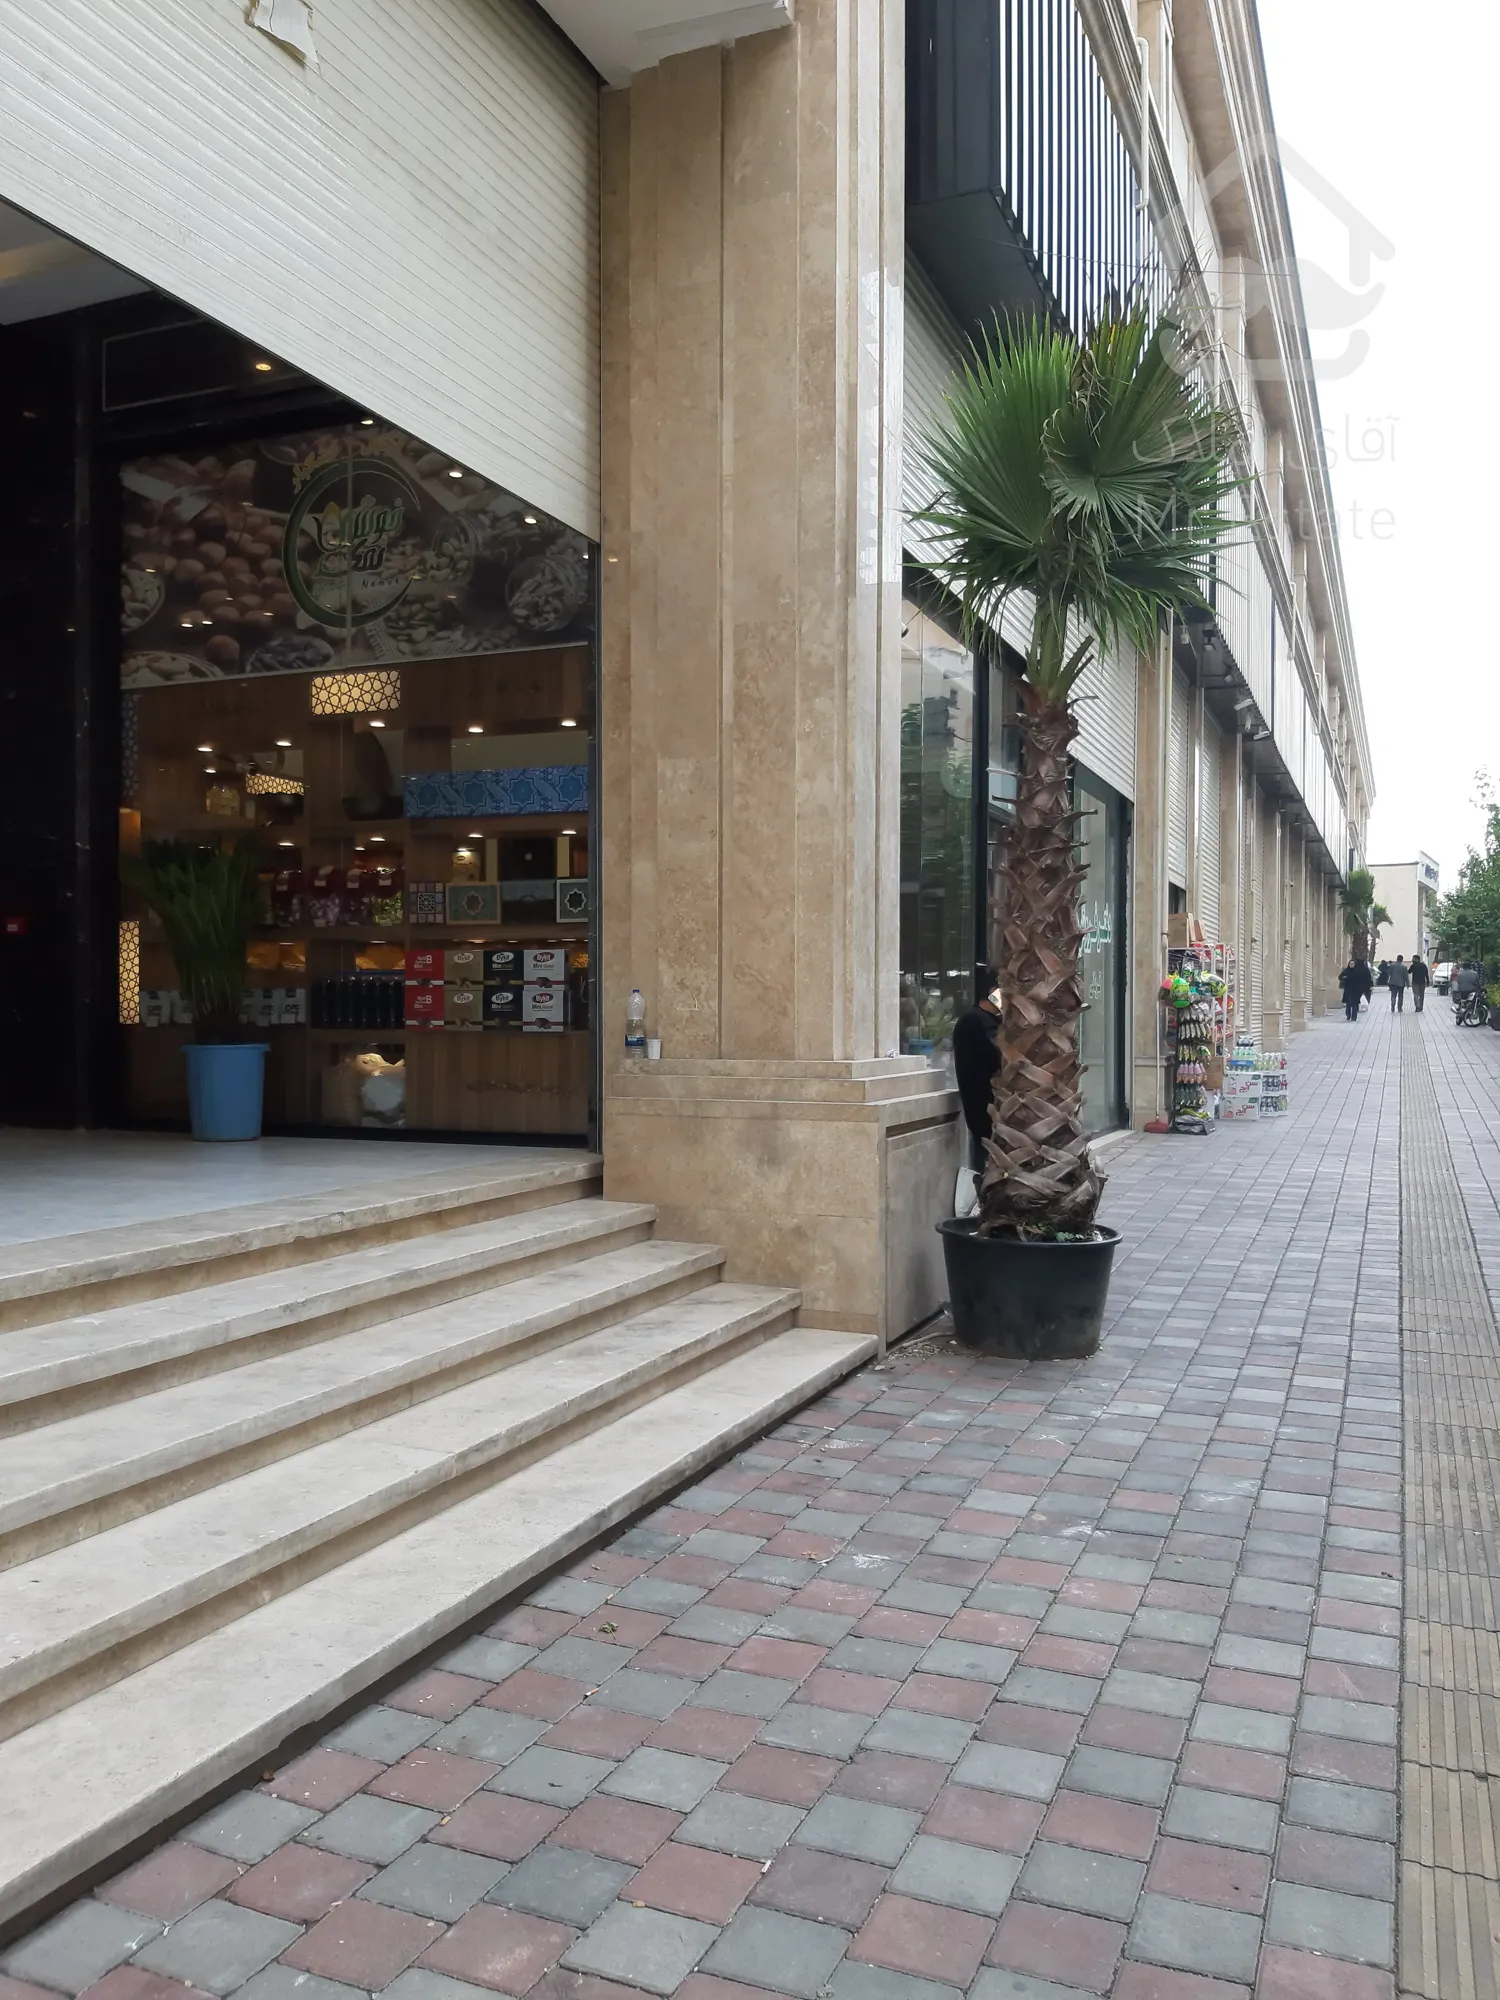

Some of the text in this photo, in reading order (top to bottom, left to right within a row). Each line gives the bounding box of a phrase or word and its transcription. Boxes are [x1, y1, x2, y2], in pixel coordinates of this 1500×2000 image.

[362, 578, 400, 589] Namak
[496, 952, 510, 962] Bykit
[536, 952, 551, 963] Bykit
[495, 993, 510, 1003] Bykit
[535, 993, 551, 1003] Bykit
